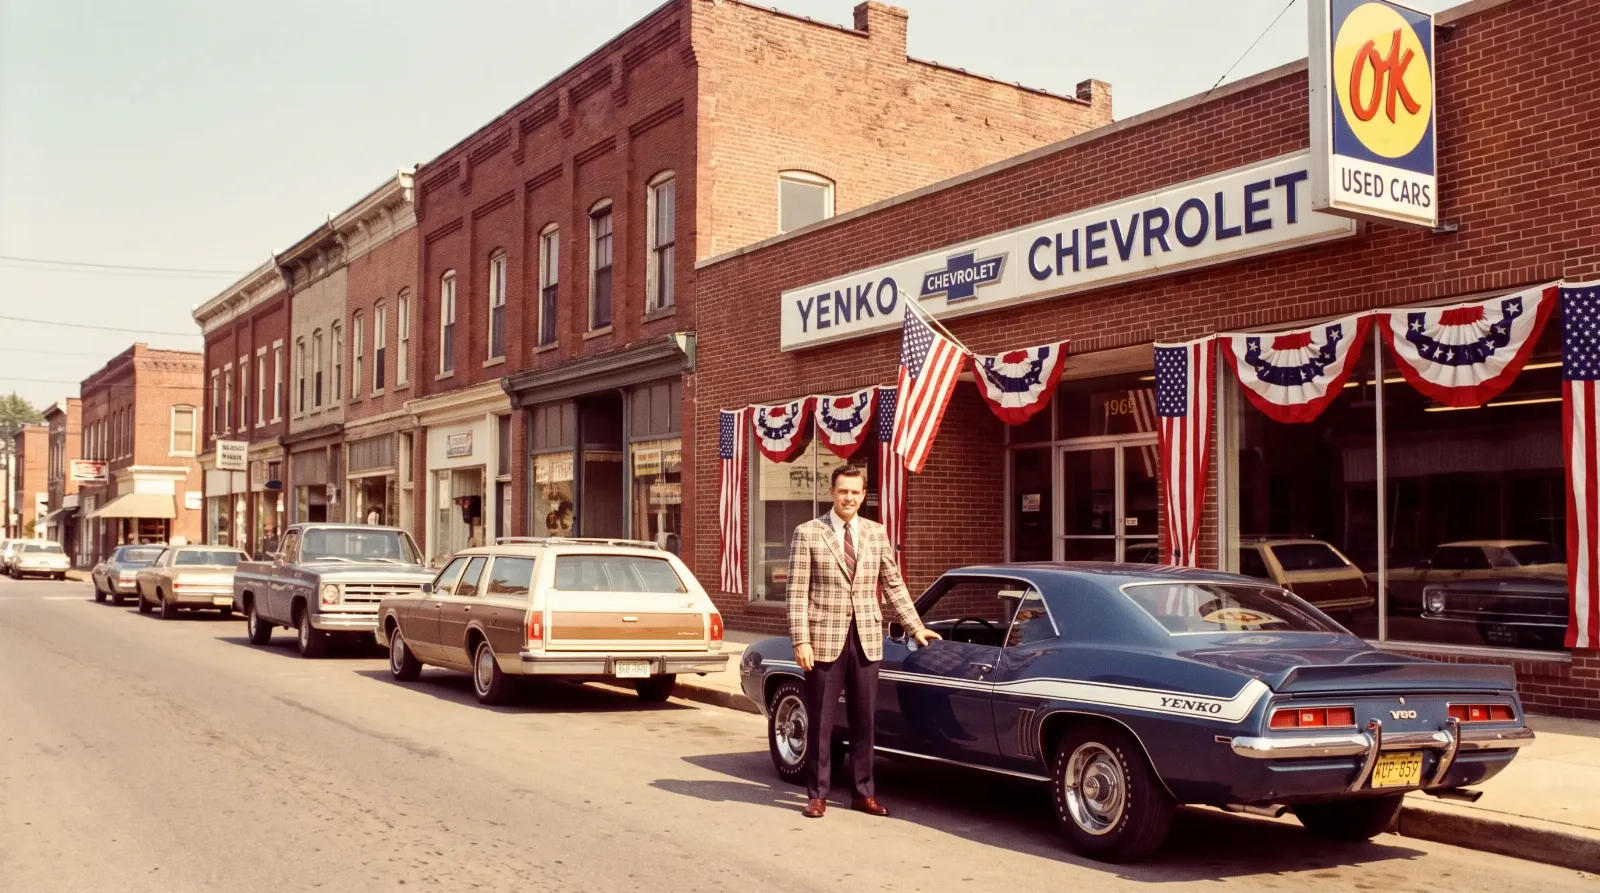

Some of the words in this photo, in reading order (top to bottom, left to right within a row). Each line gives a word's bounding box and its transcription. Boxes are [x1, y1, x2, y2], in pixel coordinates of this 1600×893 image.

[1341, 167, 1384, 198] USED
[1390, 178, 1430, 208] CARS
[796, 276, 898, 333] YENKO
[1028, 169, 1308, 281] CHEVROLET
[927, 262, 996, 291] CHEVROLET
[1104, 397, 1136, 416] 1969
[1161, 697, 1222, 714] YENKO
